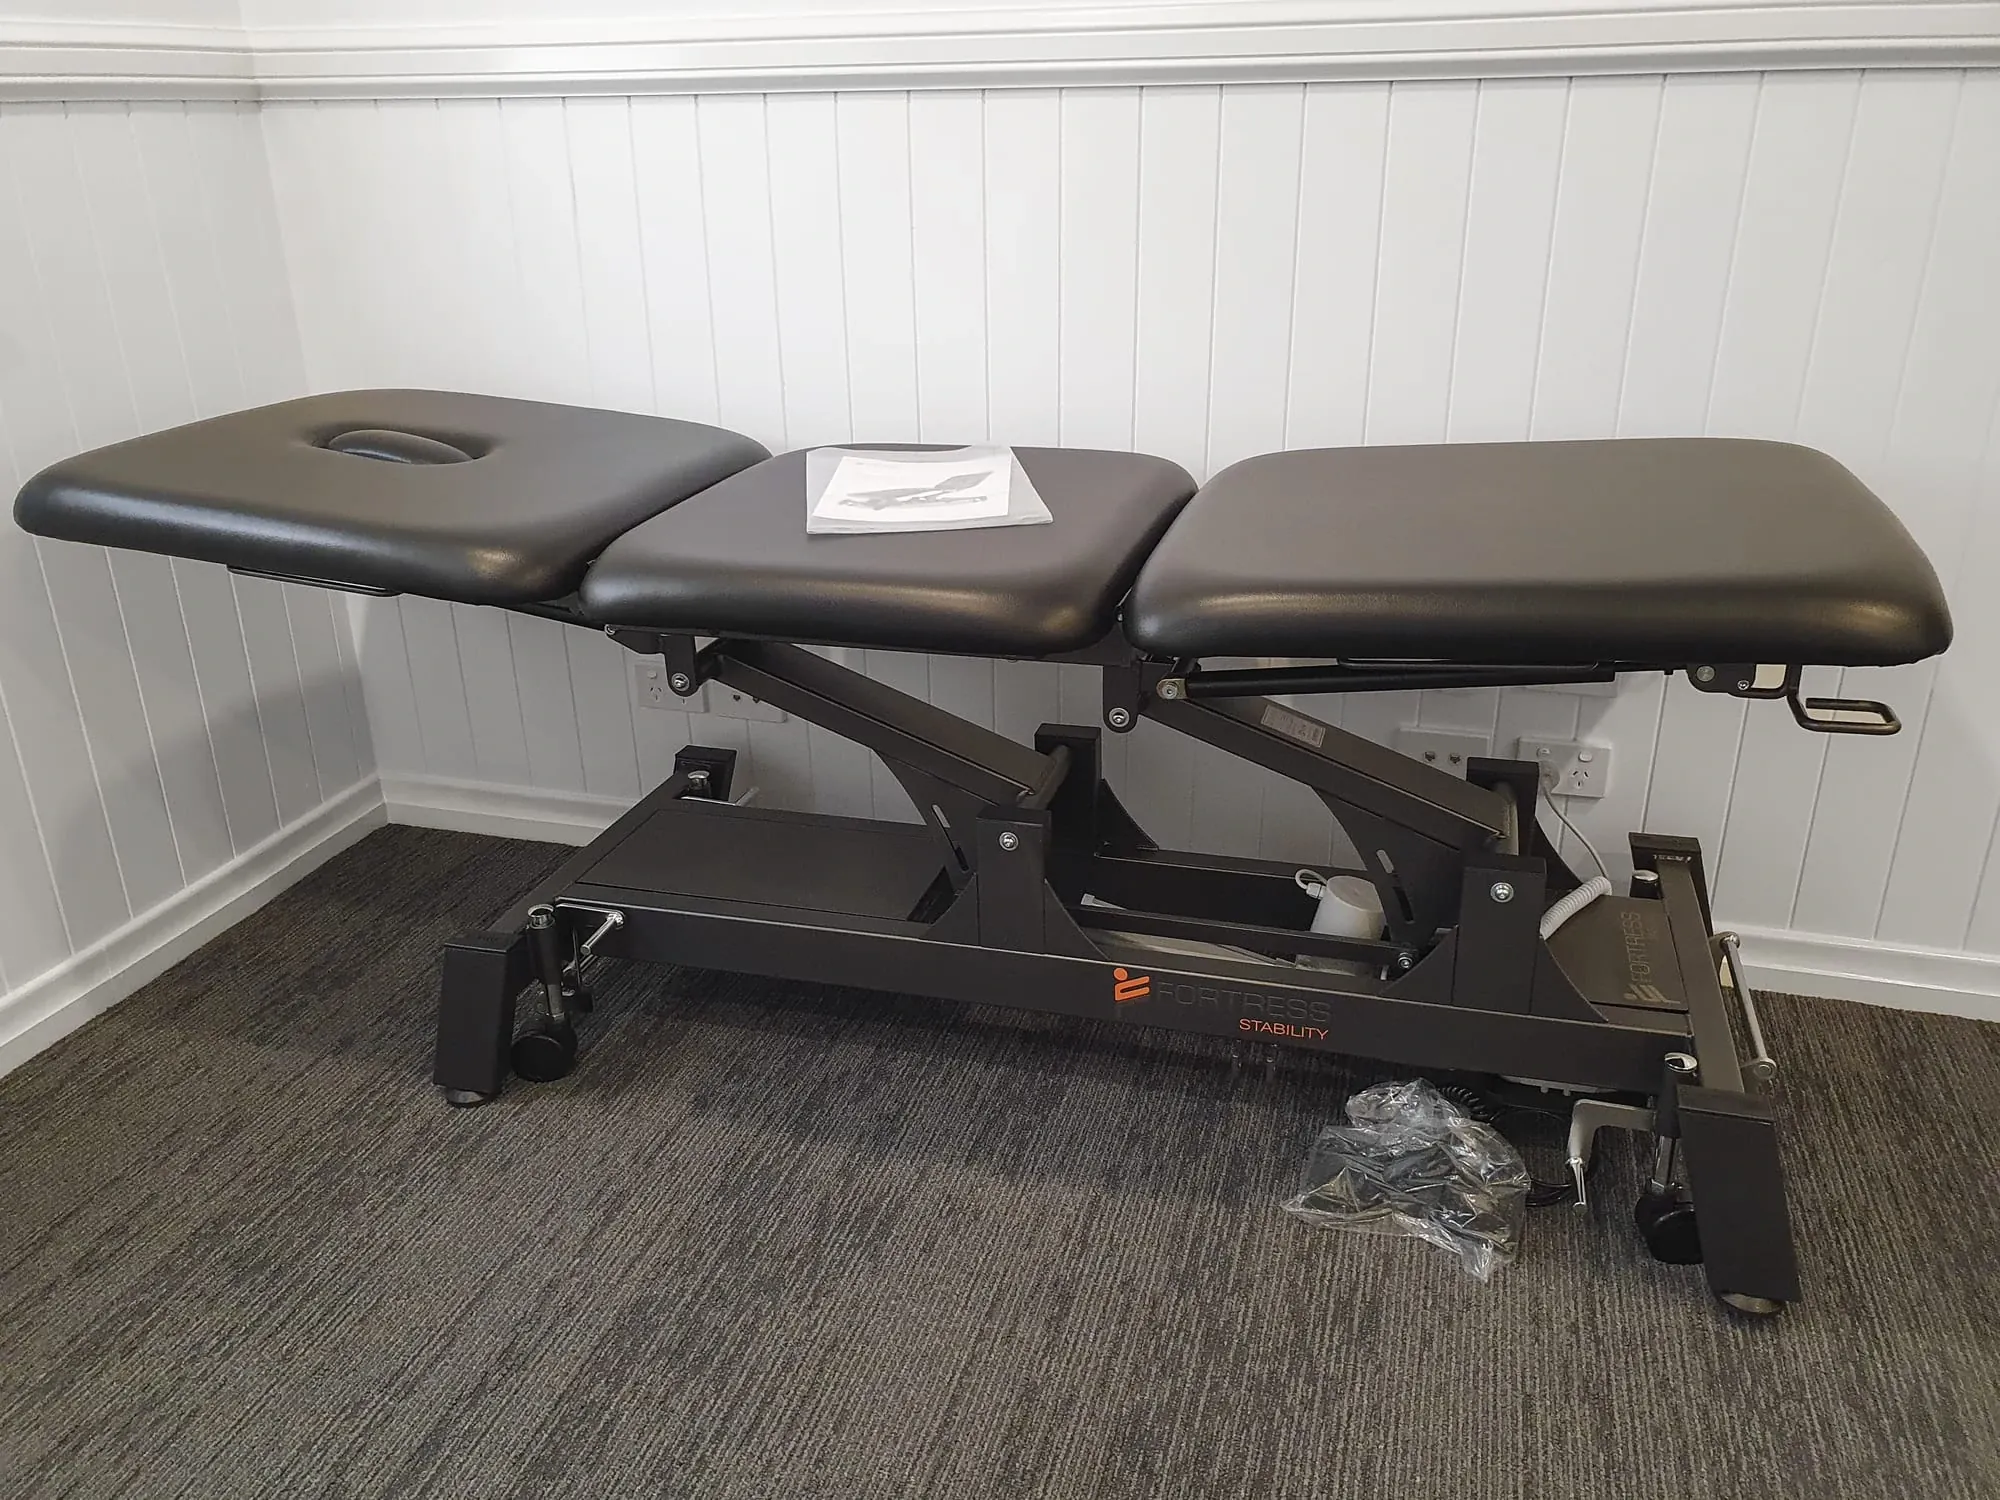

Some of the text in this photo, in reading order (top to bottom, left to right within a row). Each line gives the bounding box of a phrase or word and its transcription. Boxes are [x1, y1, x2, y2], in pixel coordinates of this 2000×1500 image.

[1620, 911, 1652, 982] FORTRESS
[1159, 981, 1332, 1022] FORTRESS
[1239, 1018, 1329, 1041] STABILITY
